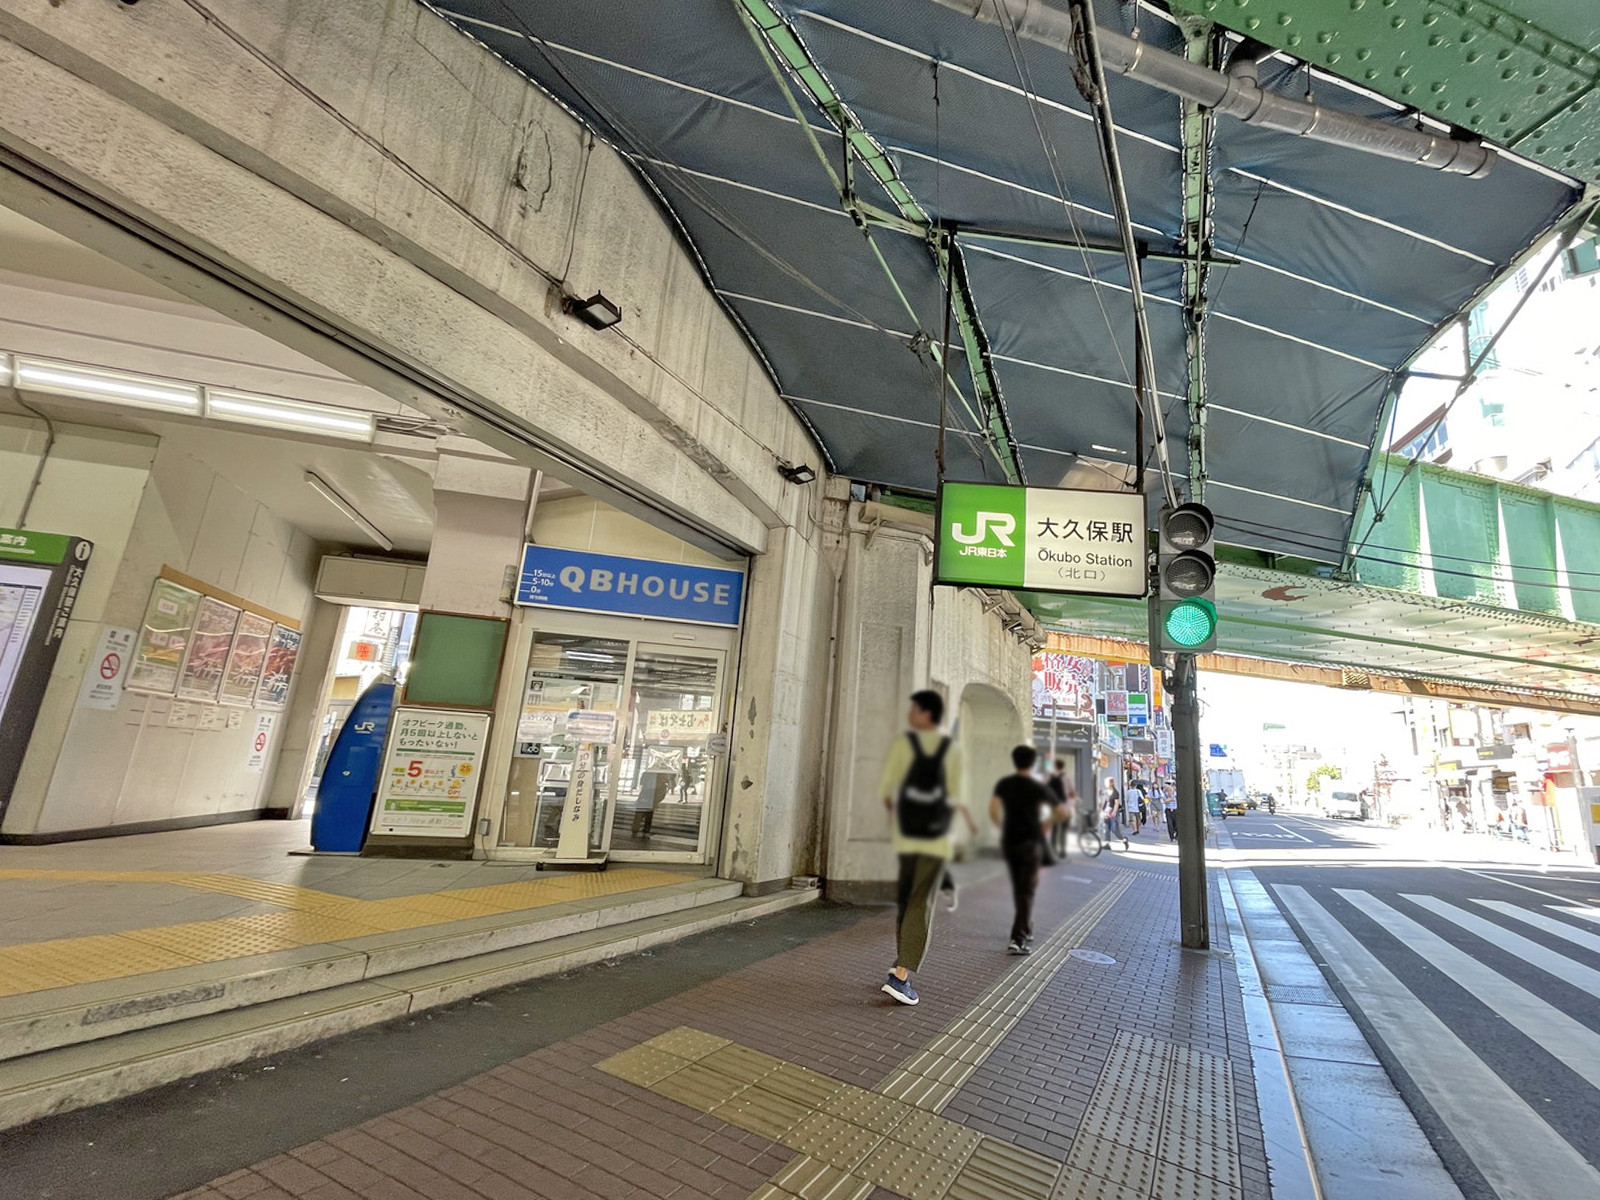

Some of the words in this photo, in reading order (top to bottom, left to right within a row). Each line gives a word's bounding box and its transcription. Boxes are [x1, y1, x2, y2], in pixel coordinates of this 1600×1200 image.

[951, 511, 1017, 547] JR
[1037, 517, 1133, 543] 大久保駅
[959, 545, 1007, 558] JR東日本
[1038, 547, 1081, 564] Ōkubo
[1085, 553, 1133, 567] Station
[1044, 671, 1079, 694] 販売
[354, 722, 376, 731] JR
[400, 728, 478, 740] 月5回以上しないと
[407, 760, 423, 777] 5
